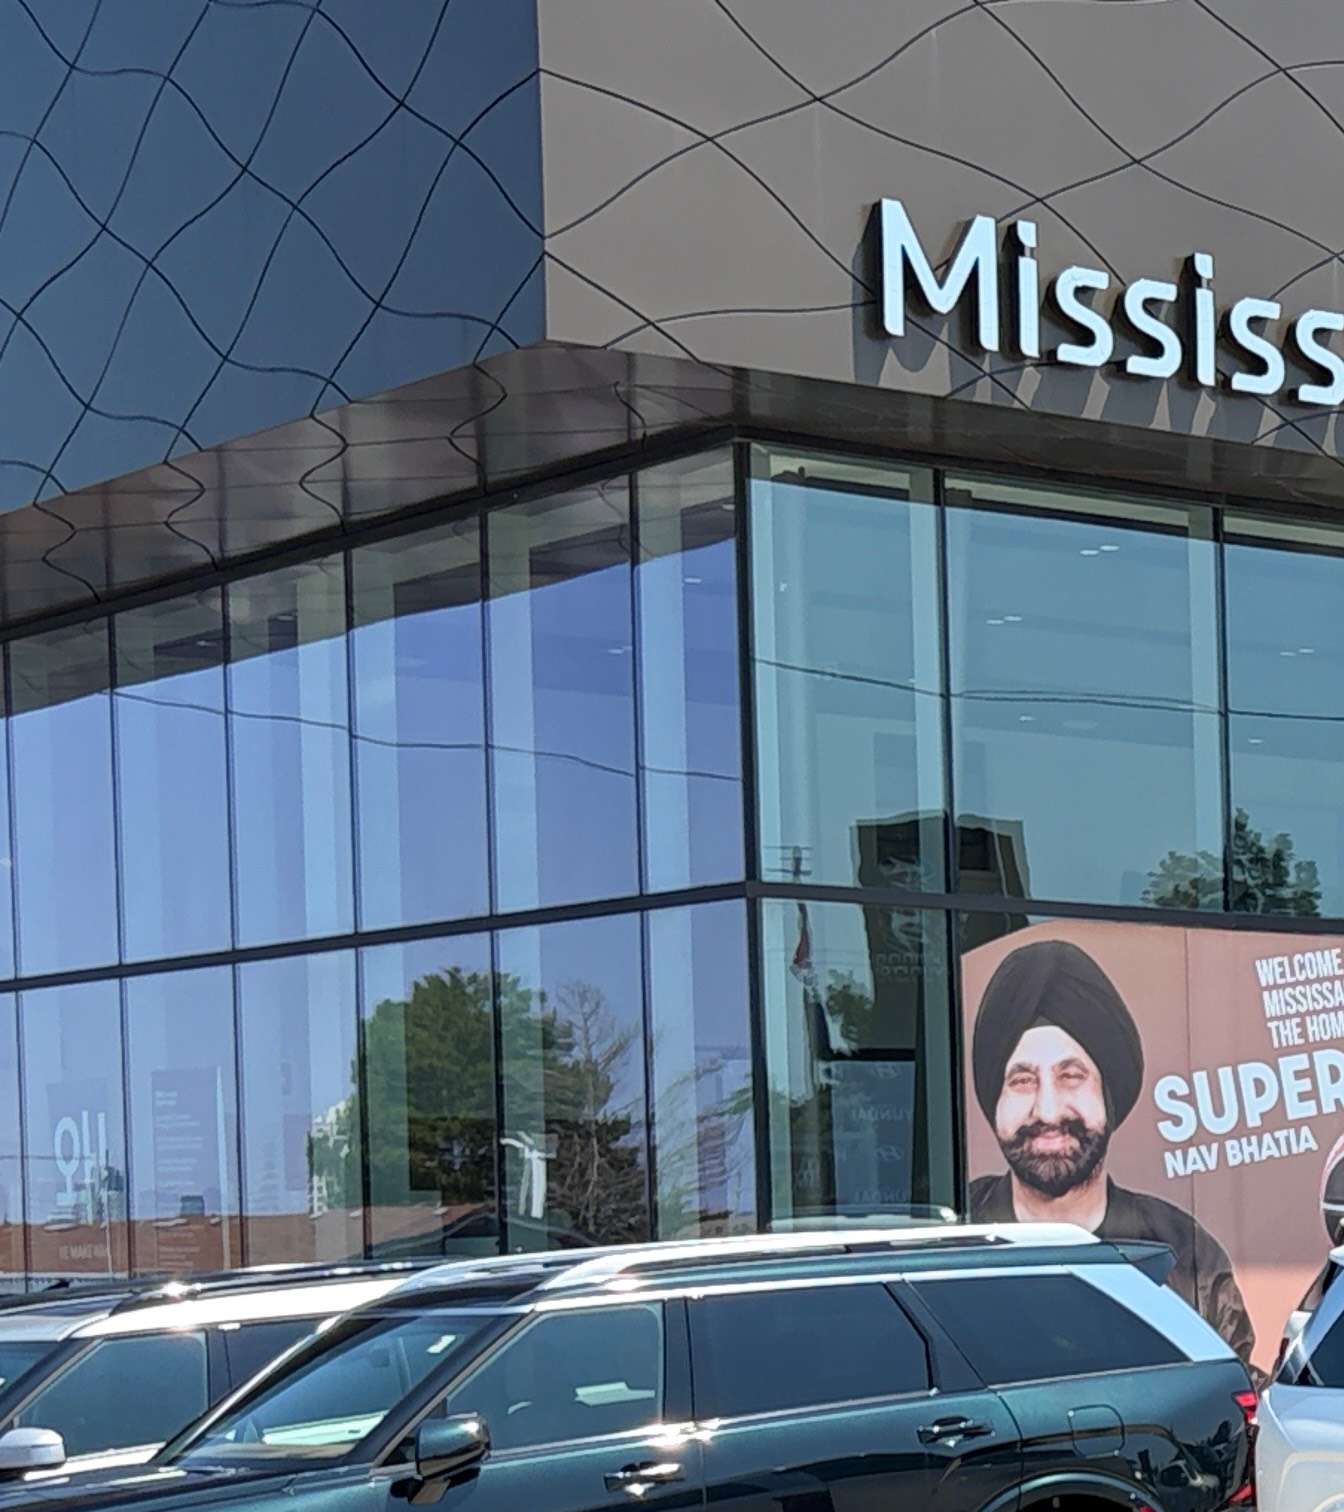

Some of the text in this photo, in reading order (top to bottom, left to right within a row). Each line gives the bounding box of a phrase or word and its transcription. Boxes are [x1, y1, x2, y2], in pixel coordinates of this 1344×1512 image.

[1255, 946, 1344, 987] WELCOME
[1266, 1017, 1305, 1048] THE
[1164, 1125, 1319, 1178] NAV BHATIA
